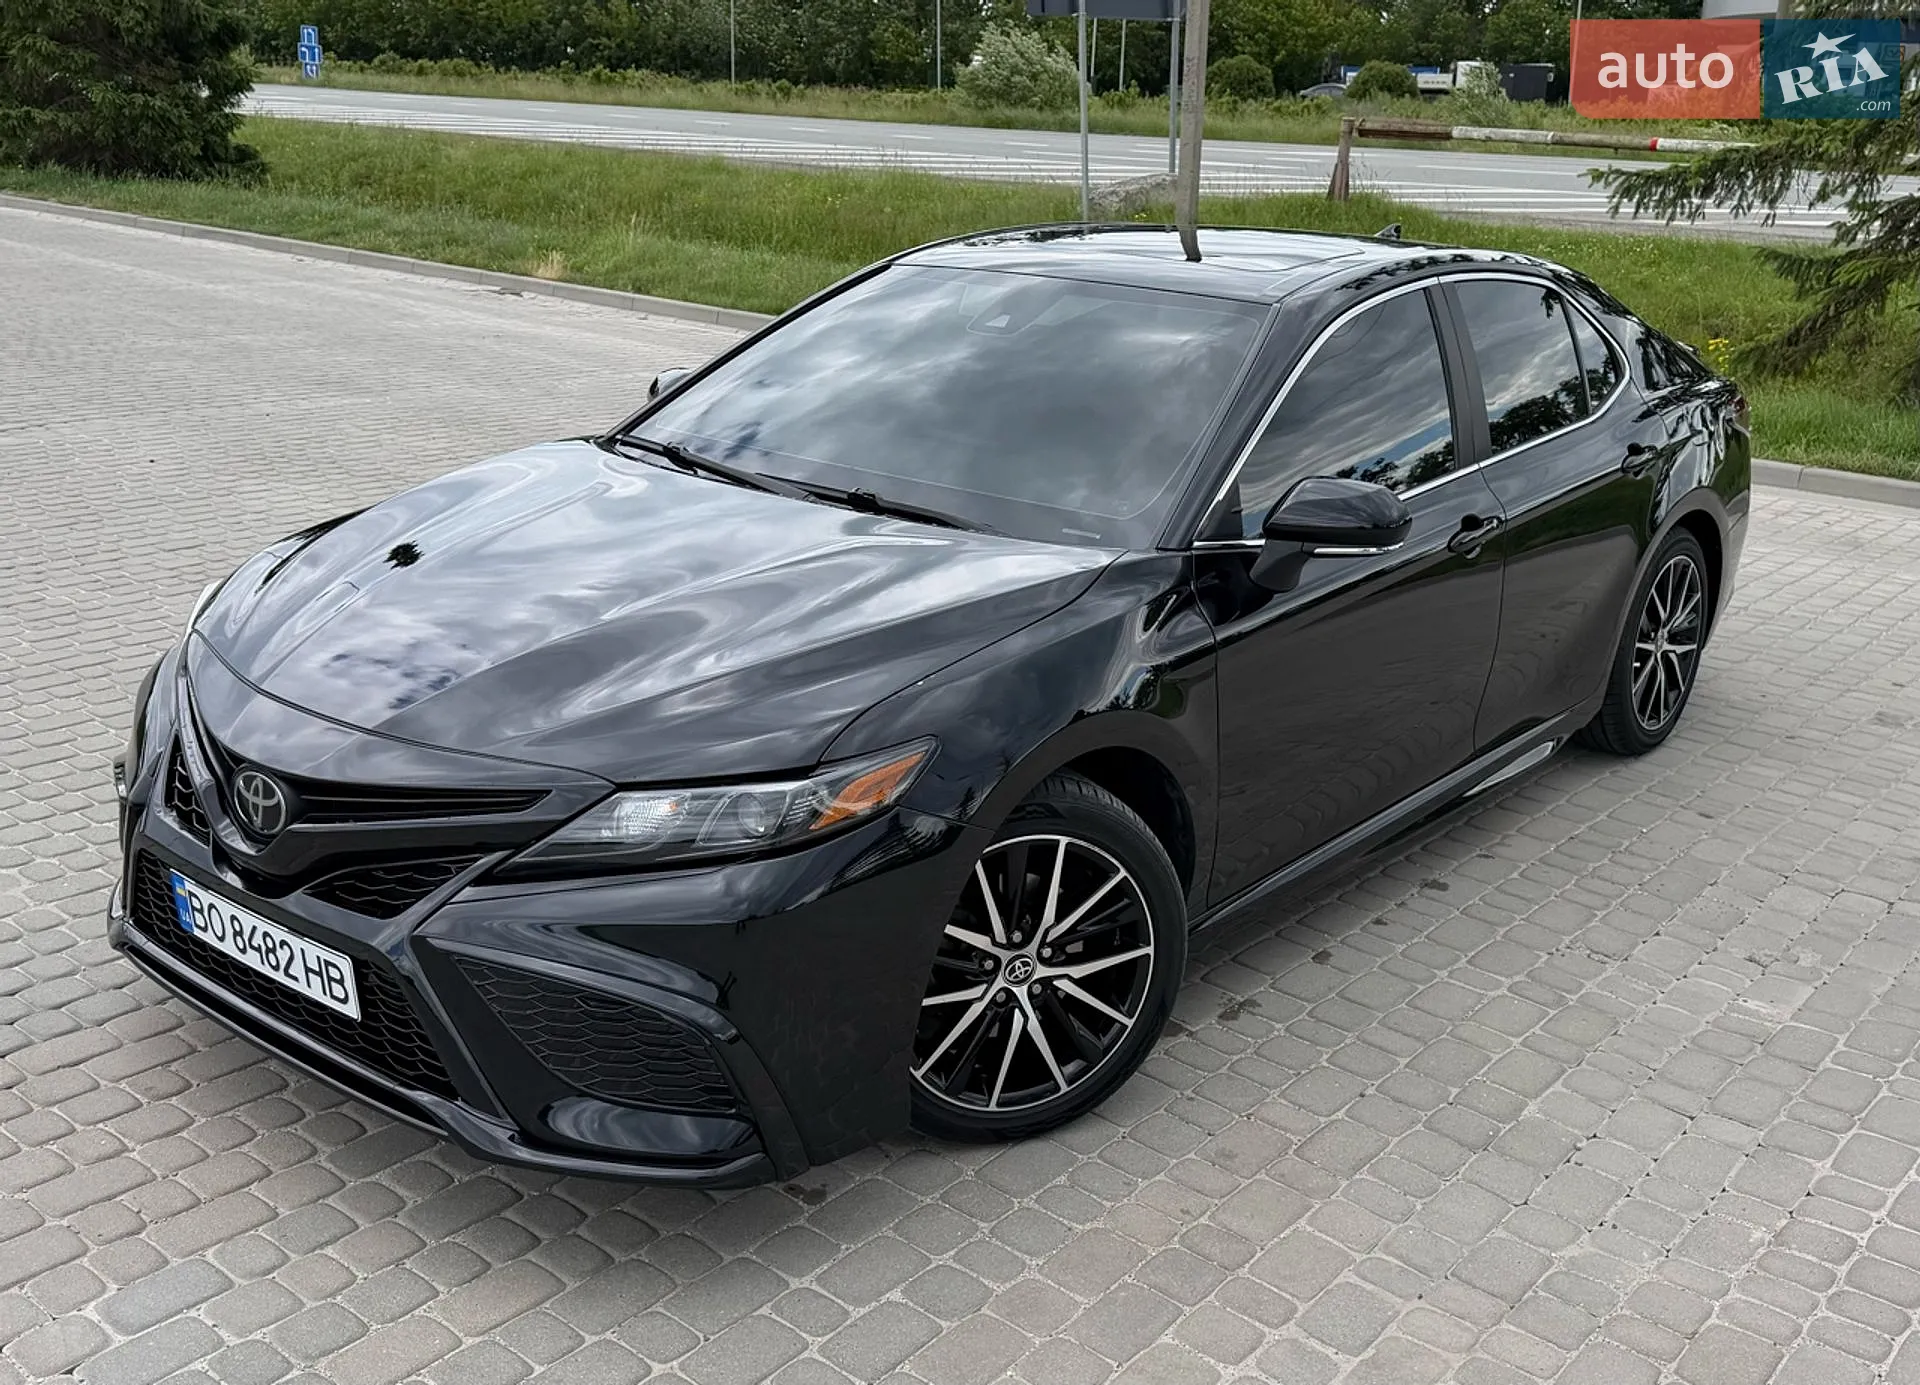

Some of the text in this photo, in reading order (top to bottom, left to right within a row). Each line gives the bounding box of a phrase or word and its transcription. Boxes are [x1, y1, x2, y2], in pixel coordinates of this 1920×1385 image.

[187, 890, 349, 1005] BO 8482 HB
